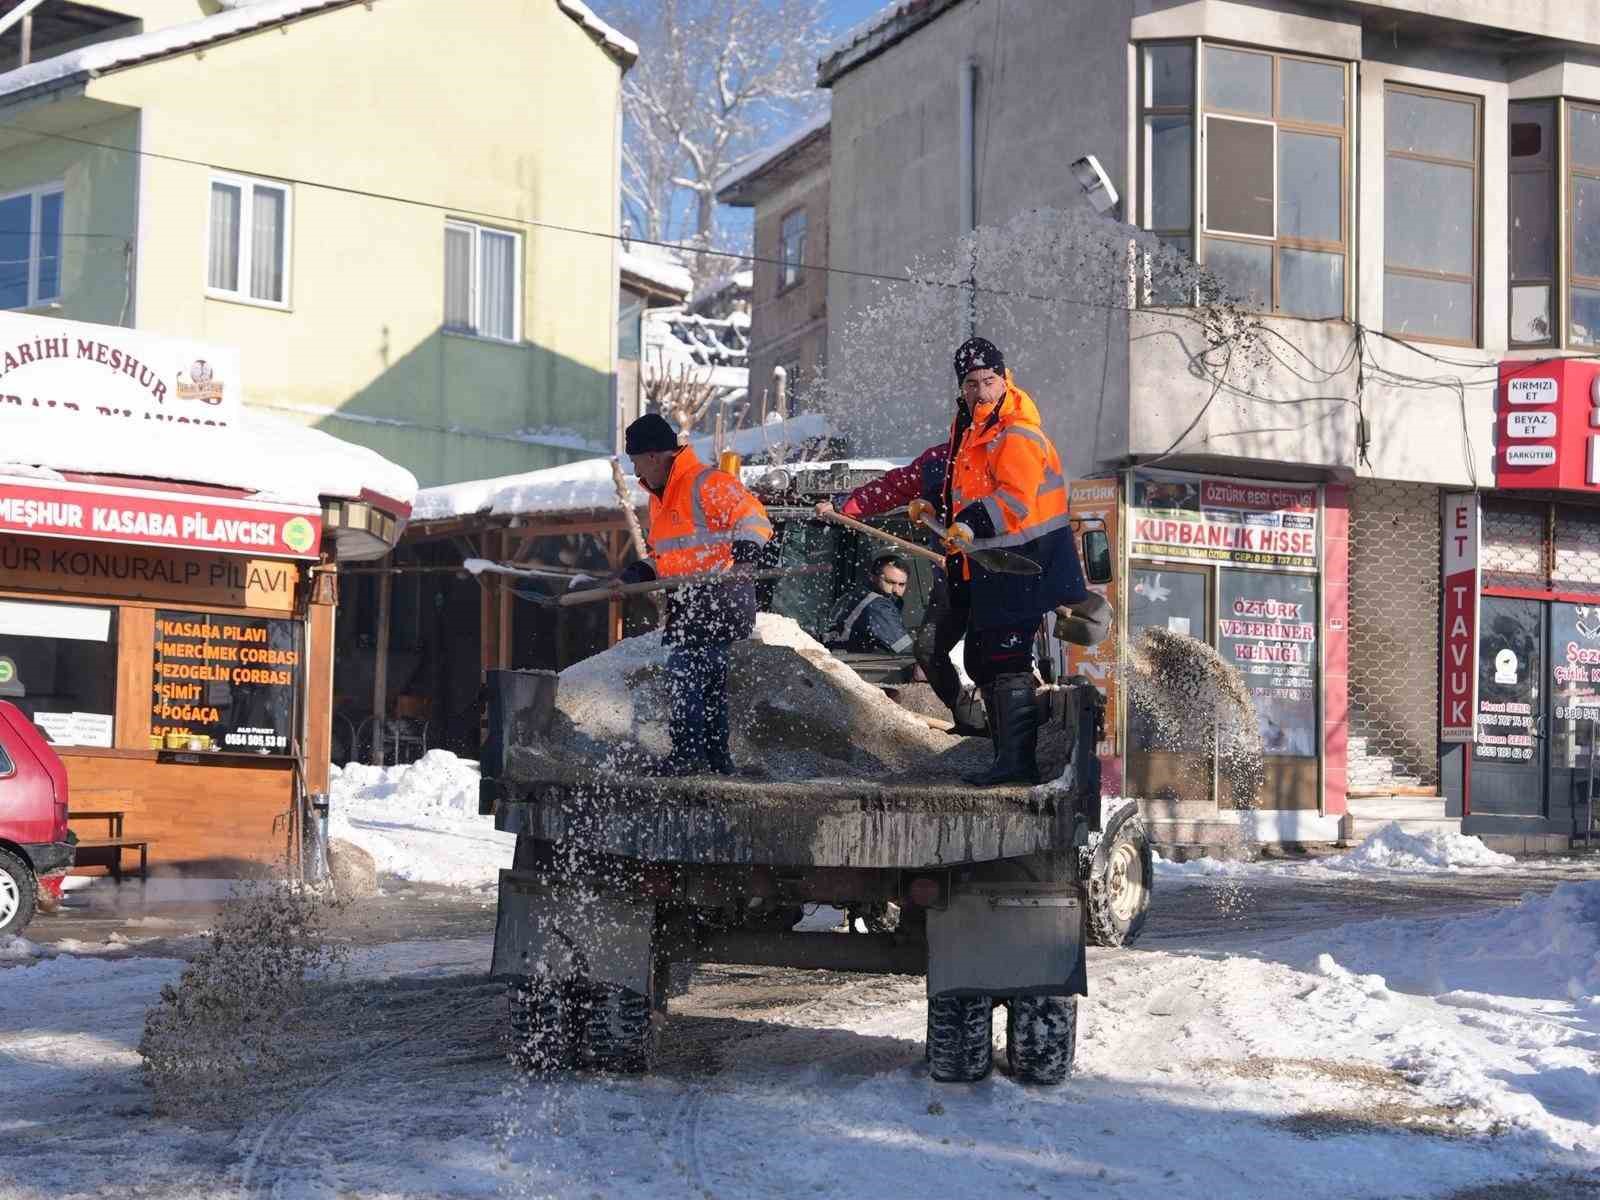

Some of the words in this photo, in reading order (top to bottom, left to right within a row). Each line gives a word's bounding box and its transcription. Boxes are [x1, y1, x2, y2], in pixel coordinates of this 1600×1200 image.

[0, 333, 69, 377] ARİHİ
[77, 338, 168, 404] MEŞHUR
[1512, 381, 1552, 391] KIRMIZI
[1525, 391, 1538, 400] ET
[1514, 415, 1548, 424] BEYAZ
[1524, 425, 1537, 434] ET
[1207, 482, 1247, 503] ÖZTÜRK
[92, 507, 178, 538] KASABA
[182, 511, 276, 546] PİLAVCISI
[1135, 519, 1253, 550] KURBANLIK
[1454, 507, 1468, 557] ET
[50, 548, 201, 585] KONURALP
[1233, 598, 1302, 620] ÖZTÜRK
[164, 621, 221, 639] KASABA
[223, 626, 267, 643] PİLAVI
[1220, 618, 1315, 642] VETERİNER
[163, 642, 237, 661] MERCİMEK
[239, 648, 299, 665] ÇORBASI
[1451, 586, 1469, 723] TAVUK
[163, 663, 230, 681] EZOGELİN
[232, 668, 292, 685] ÇORBASI
[161, 683, 203, 700] SİMİT
[161, 704, 220, 725] POĞAÇA
